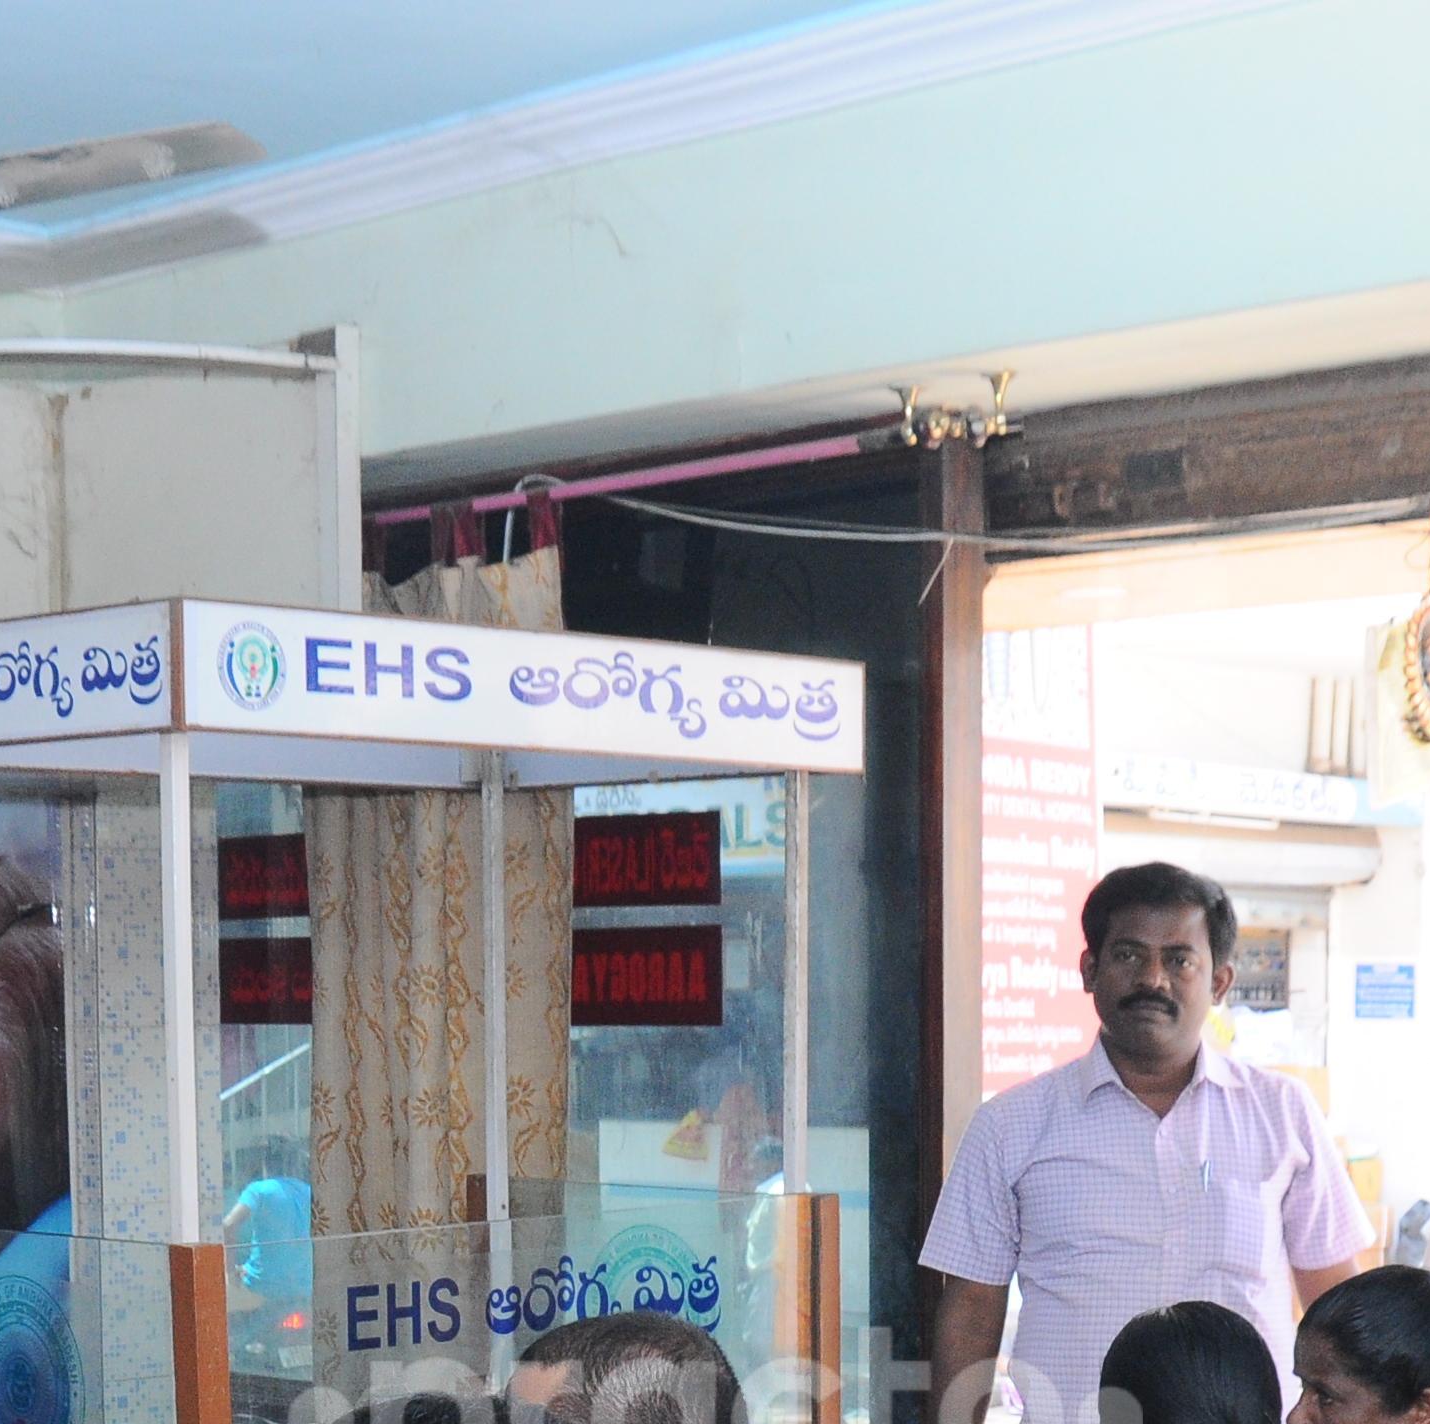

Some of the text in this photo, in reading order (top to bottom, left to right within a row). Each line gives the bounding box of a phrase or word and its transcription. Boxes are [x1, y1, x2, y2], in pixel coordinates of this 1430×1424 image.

[81, 636, 163, 704] మిత్ర
[306, 637, 472, 701] EHS
[509, 650, 707, 739] ఆరోగ్య
[718, 675, 841, 742] మిత్ర
[347, 1278, 461, 1352] EHS
